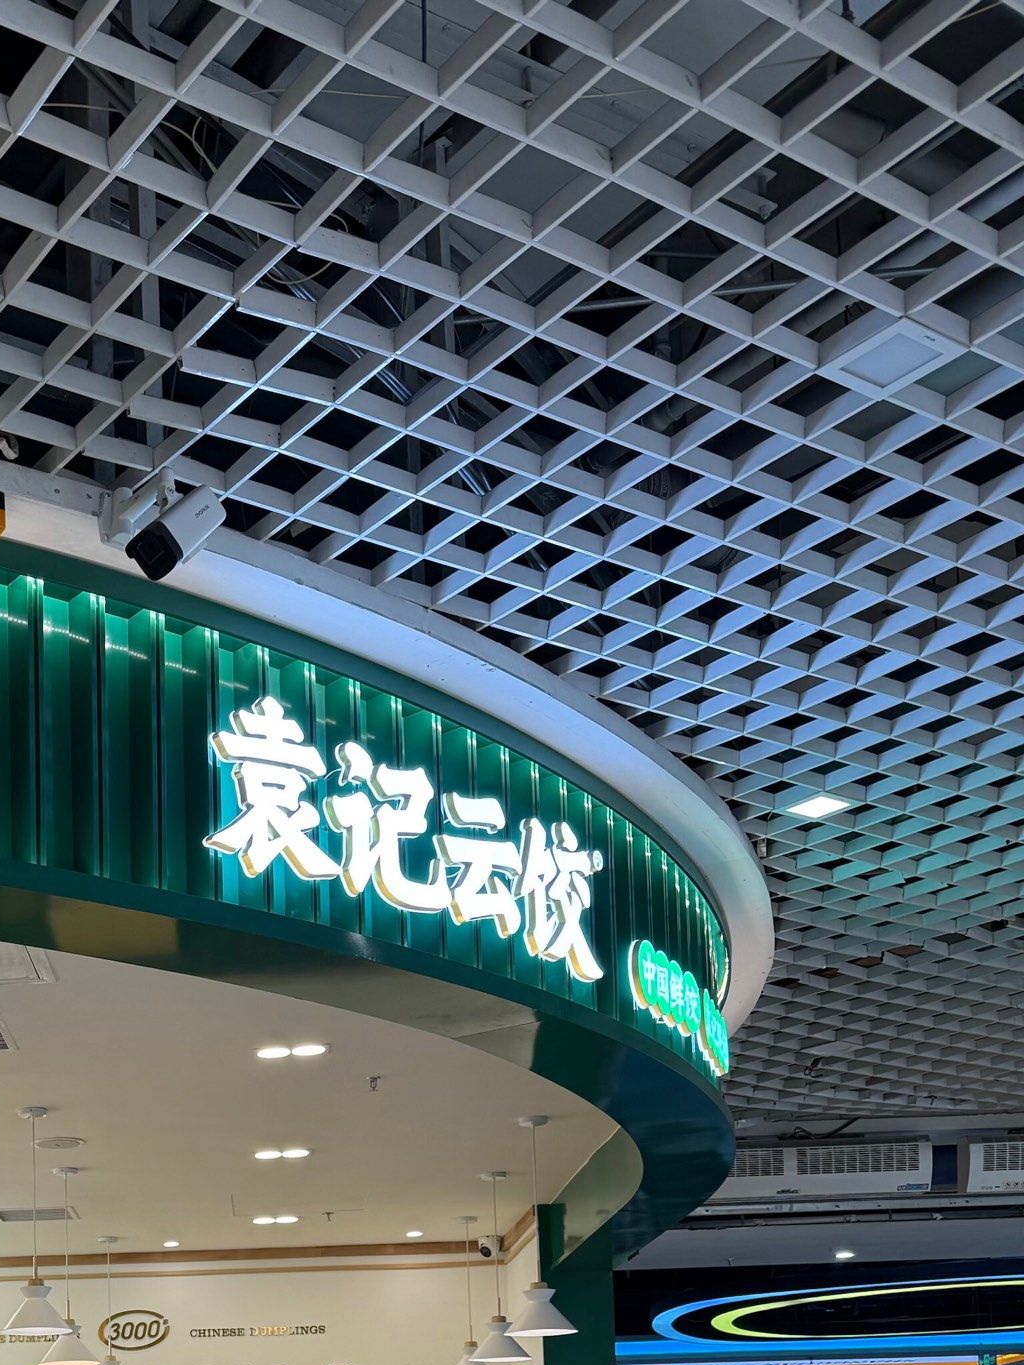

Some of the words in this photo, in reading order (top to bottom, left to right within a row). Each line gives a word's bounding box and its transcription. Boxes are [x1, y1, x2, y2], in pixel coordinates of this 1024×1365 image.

[202, 696, 604, 982] 袁记云饺
[110, 1320, 161, 1341] 3000
[189, 1327, 245, 1338] CHINESE
[250, 1325, 326, 1336] DUMPLINGS
